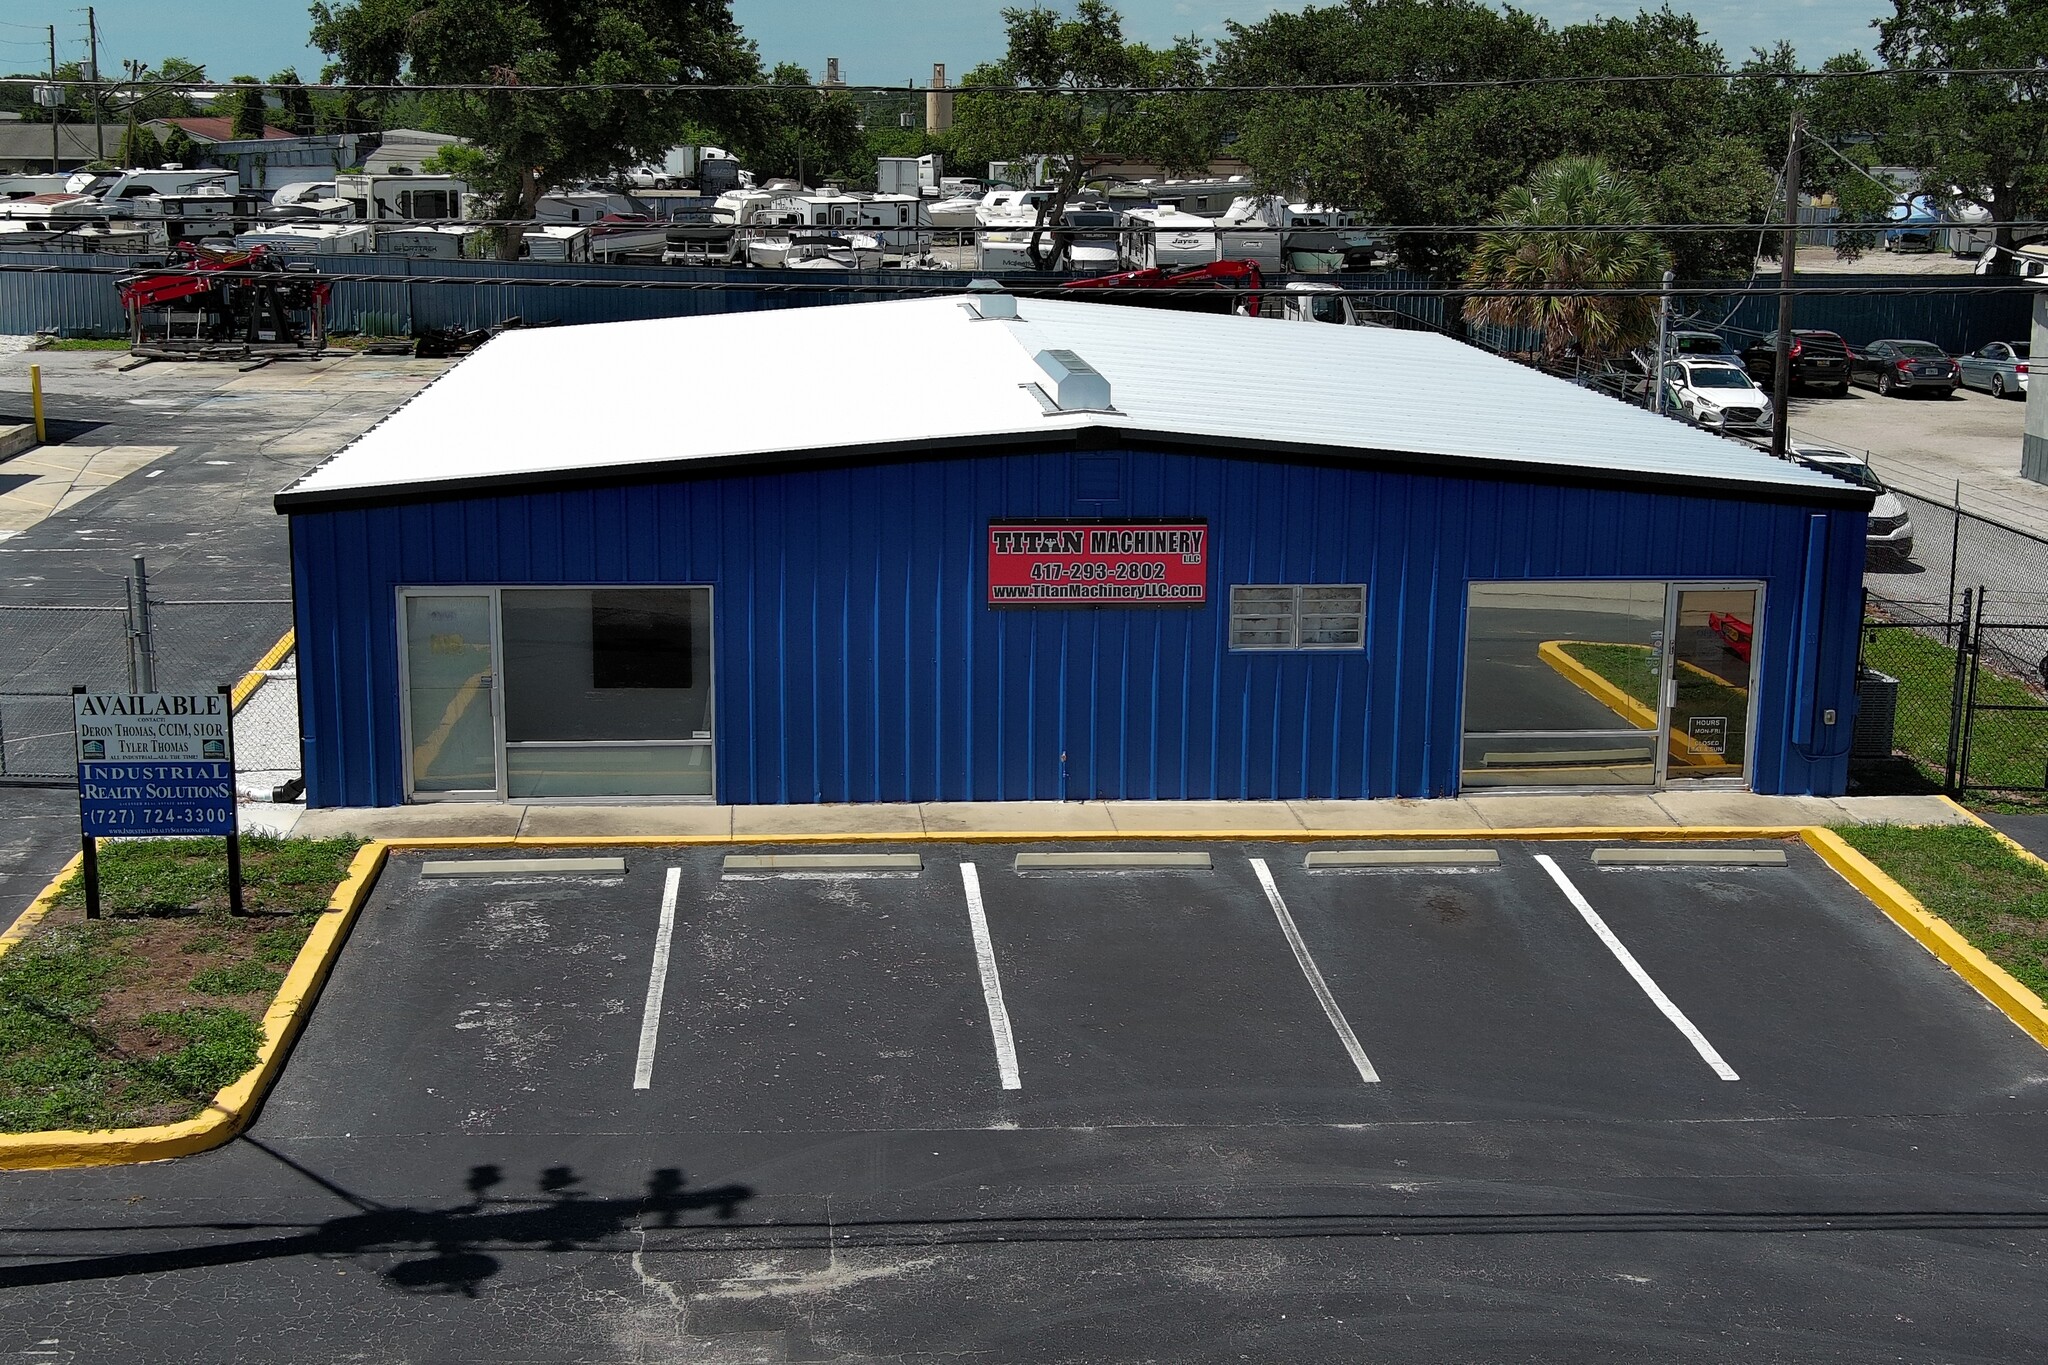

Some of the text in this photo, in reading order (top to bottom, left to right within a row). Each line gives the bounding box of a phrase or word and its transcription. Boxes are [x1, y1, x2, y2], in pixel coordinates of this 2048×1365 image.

[993, 530, 1204, 554] TITAN MACHINERY
[1182, 554, 1201, 564] LLC
[1031, 562, 1165, 581] 417-293-2802
[993, 583, 1202, 599] www.TitanMachineryLLC.com
[81, 696, 221, 716] AVAILABLE
[82, 725, 113, 737] DERON
[158, 723, 192, 739] CCIM,
[194, 723, 223, 737] SIOR
[119, 739, 189, 753] TYLER THOMAS
[84, 763, 228, 780] INDUSTRIAL
[85, 782, 229, 799] REALTY SOLUTIONS
[91, 808, 226, 825] (727) 724-3300
